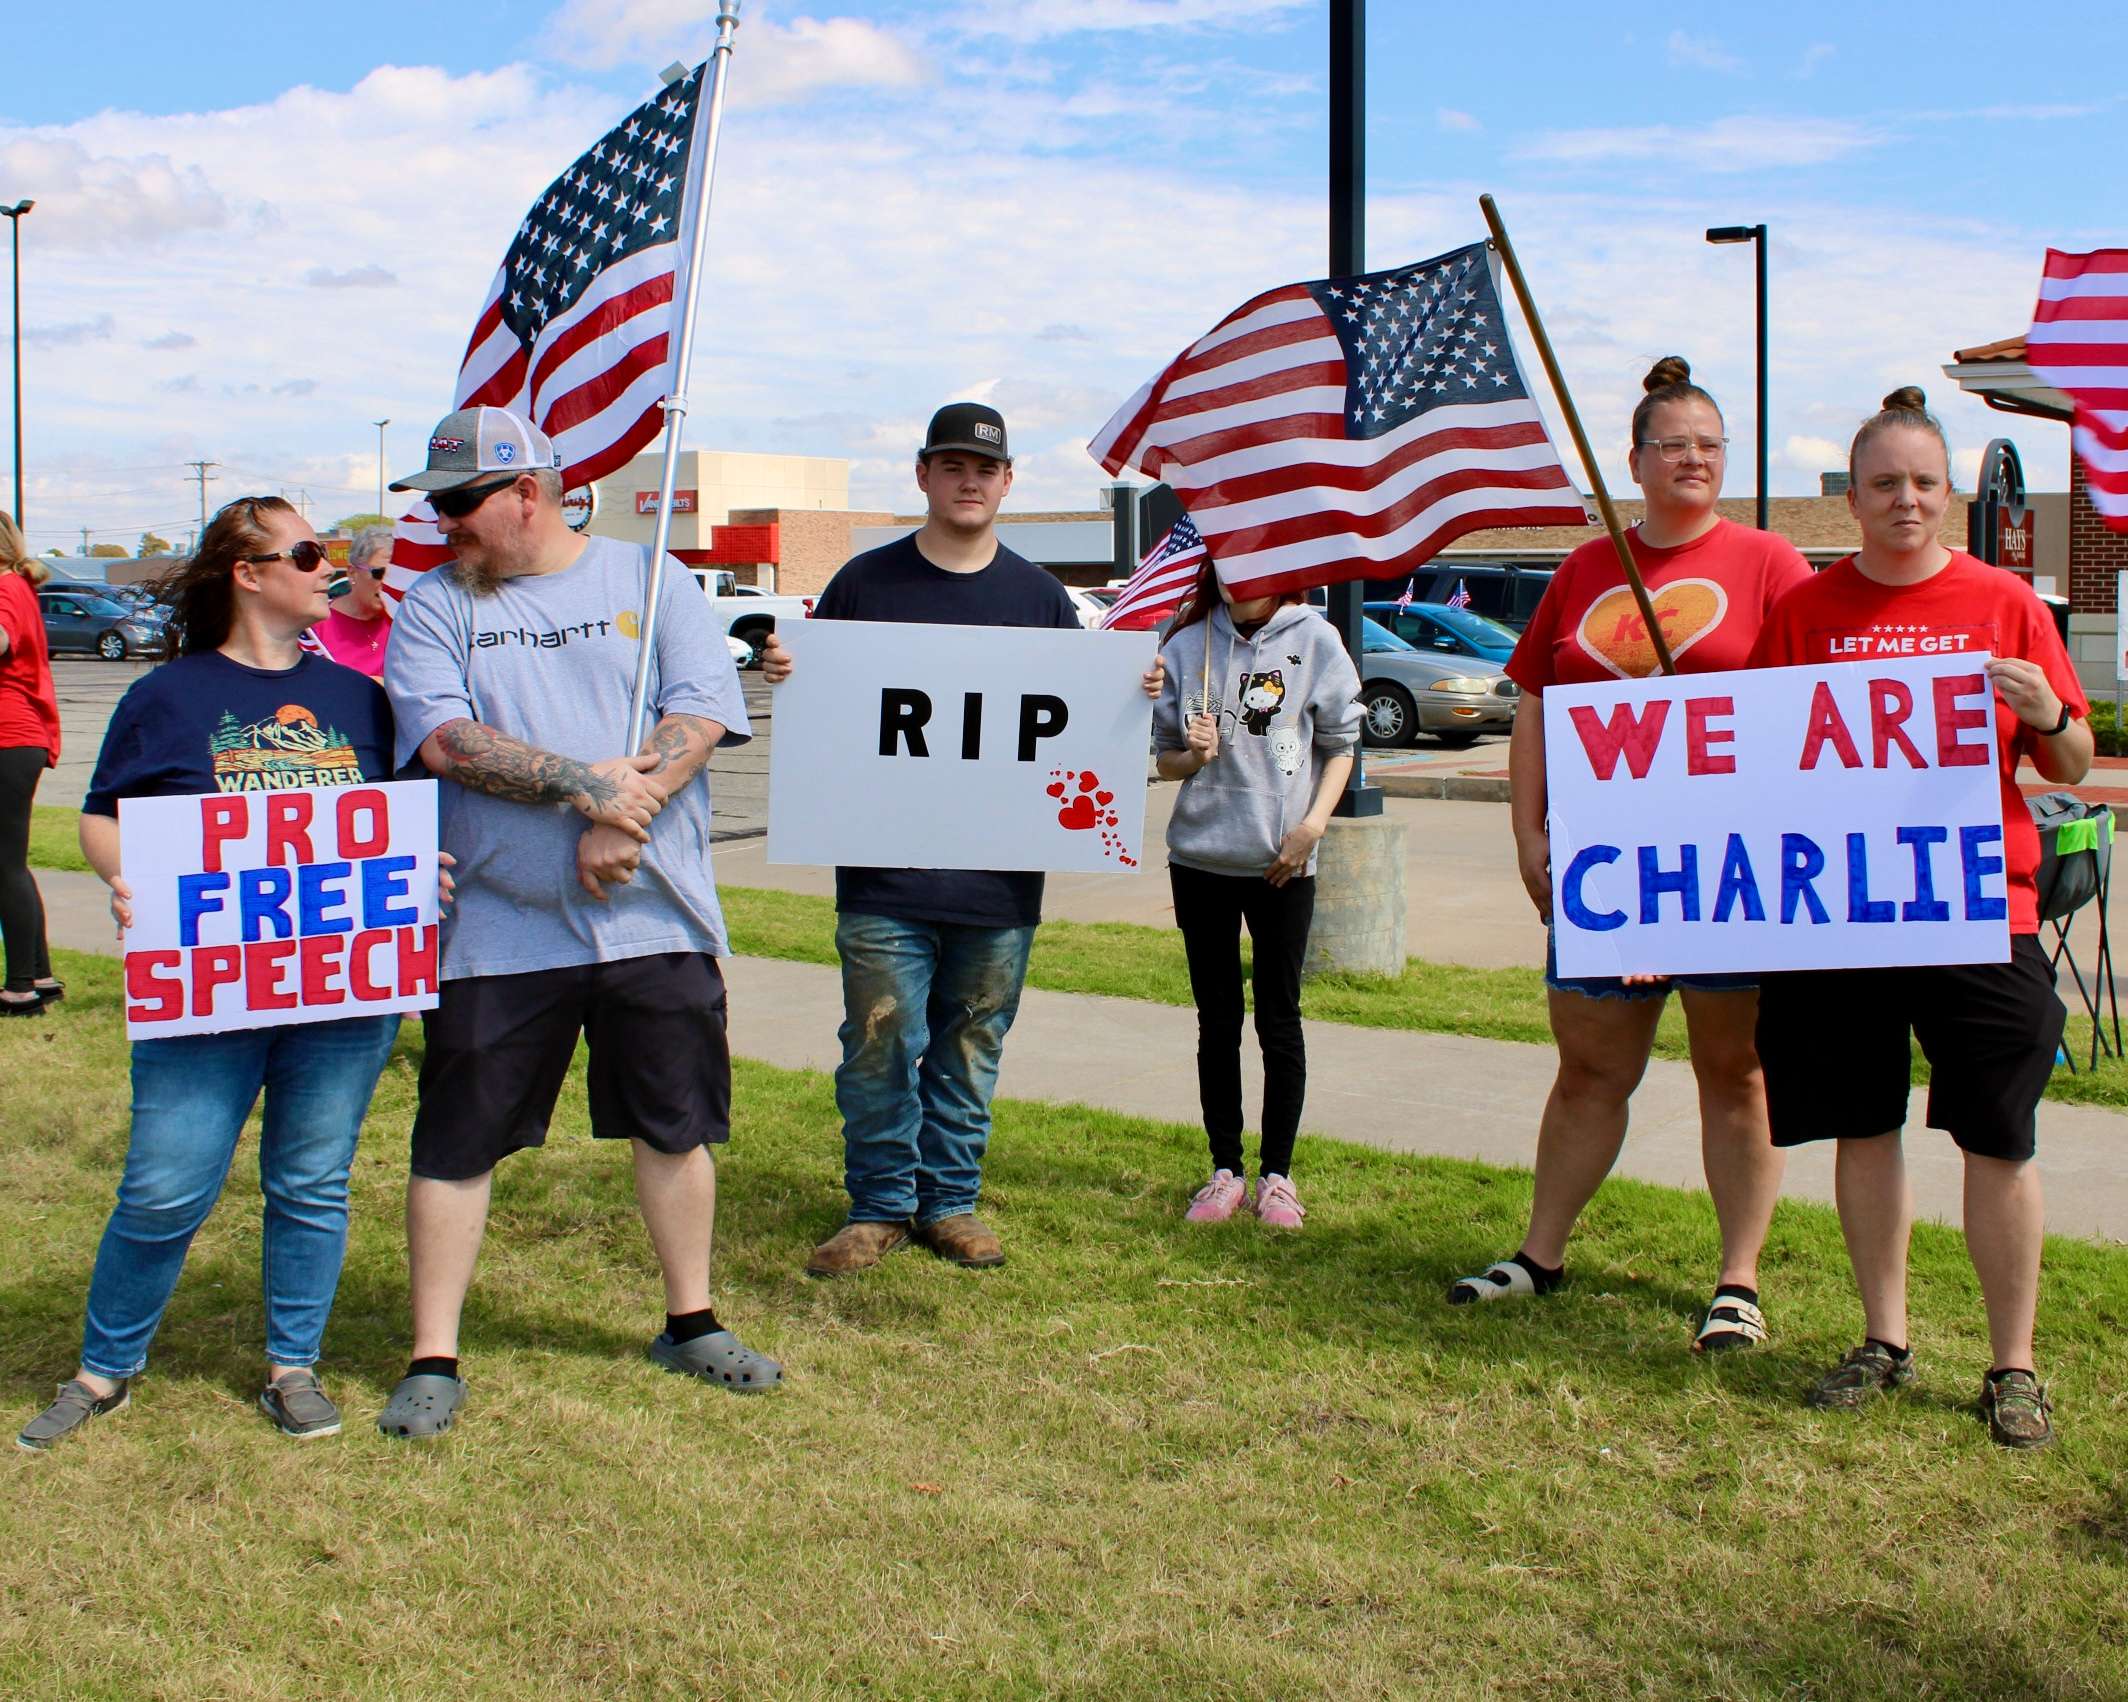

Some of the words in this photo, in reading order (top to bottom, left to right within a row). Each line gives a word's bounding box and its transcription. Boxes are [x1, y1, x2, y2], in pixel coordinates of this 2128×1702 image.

[979, 425, 999, 440] RM
[1830, 636, 1873, 654] LET
[1877, 637, 1915, 653] ME
[1919, 634, 1970, 652] GET
[1569, 696, 1737, 781] WE
[1799, 674, 1990, 771] ARE
[214, 766, 366, 793] WANDERER
[200, 788, 391, 873] PRO
[177, 855, 419, 947] FREE
[1562, 824, 2007, 932] CHARLIE
[124, 924, 440, 1023] SPEECH
